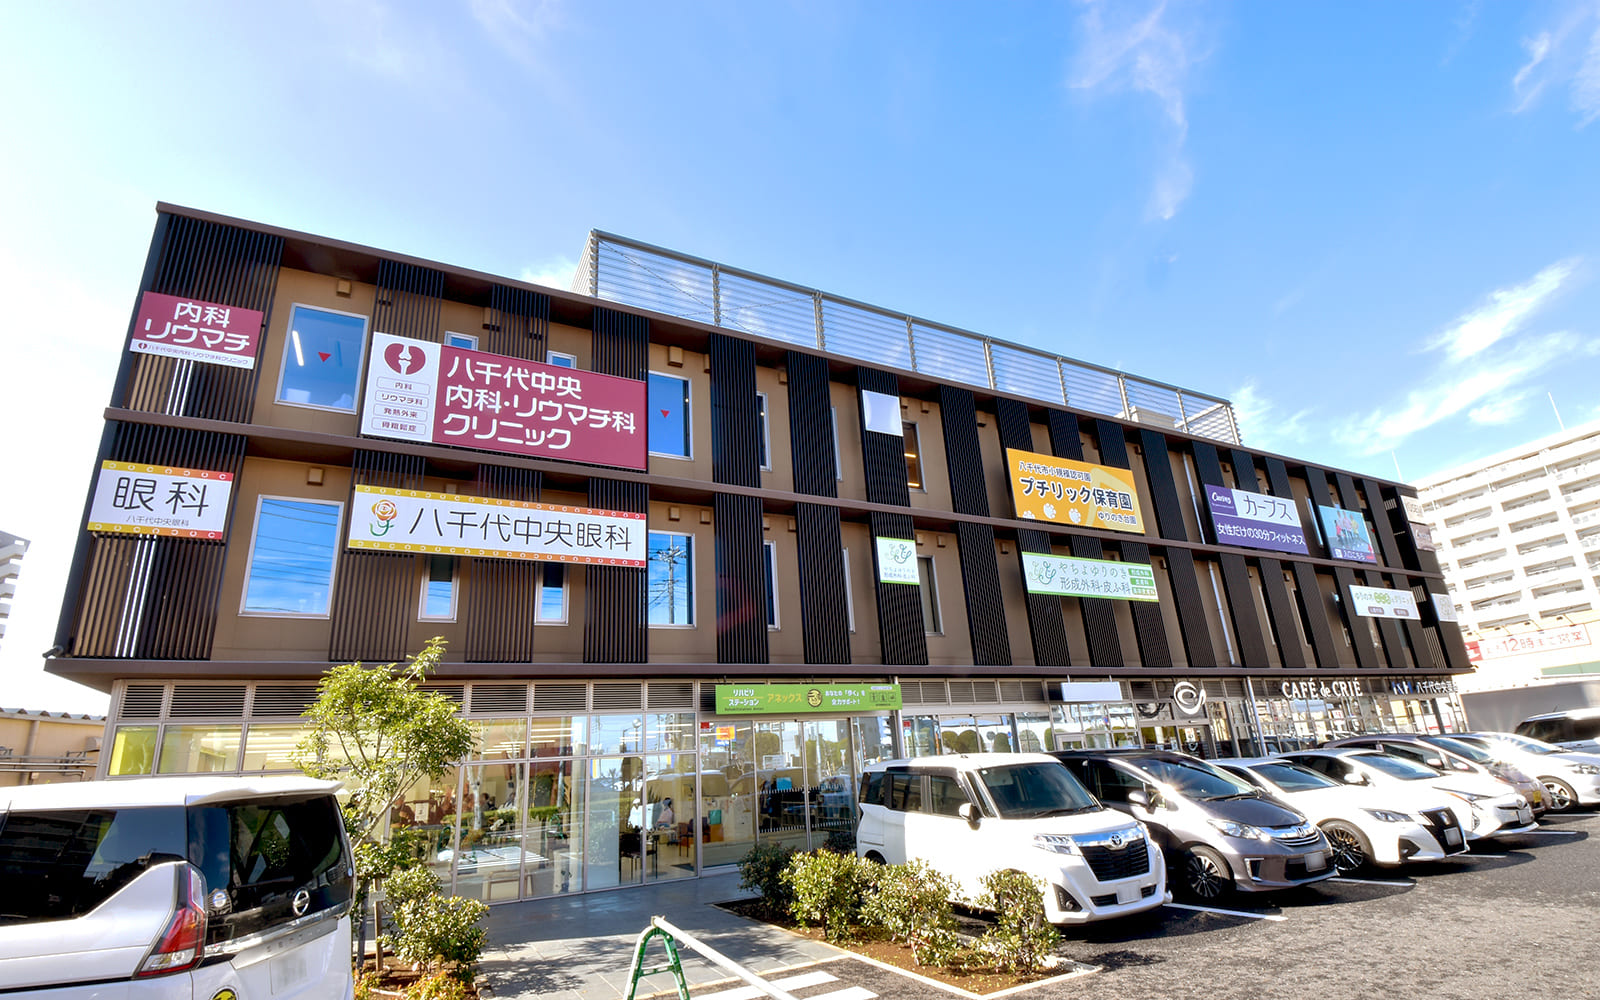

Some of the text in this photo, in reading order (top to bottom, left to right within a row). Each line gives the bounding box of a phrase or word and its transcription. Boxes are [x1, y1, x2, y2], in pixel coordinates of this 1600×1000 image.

[174, 302, 230, 328] 内科
[145, 318, 250, 352] リウマチ
[395, 382, 412, 390] 内科
[447, 355, 582, 400] 八千代中央
[382, 393, 423, 406] リウマチ科
[445, 384, 636, 435] 内科・リウマチ科
[443, 413, 572, 450] クリニック
[112, 477, 209, 518] 眼科
[1020, 477, 1133, 511] プチリック保育園
[126, 514, 190, 528] 八千代中央眼科
[409, 507, 632, 552] 八千代中央眼科
[767, 693, 802, 704] アネックス
[1281, 677, 1319, 699] CAFÉ
[1319, 680, 1332, 697] de
